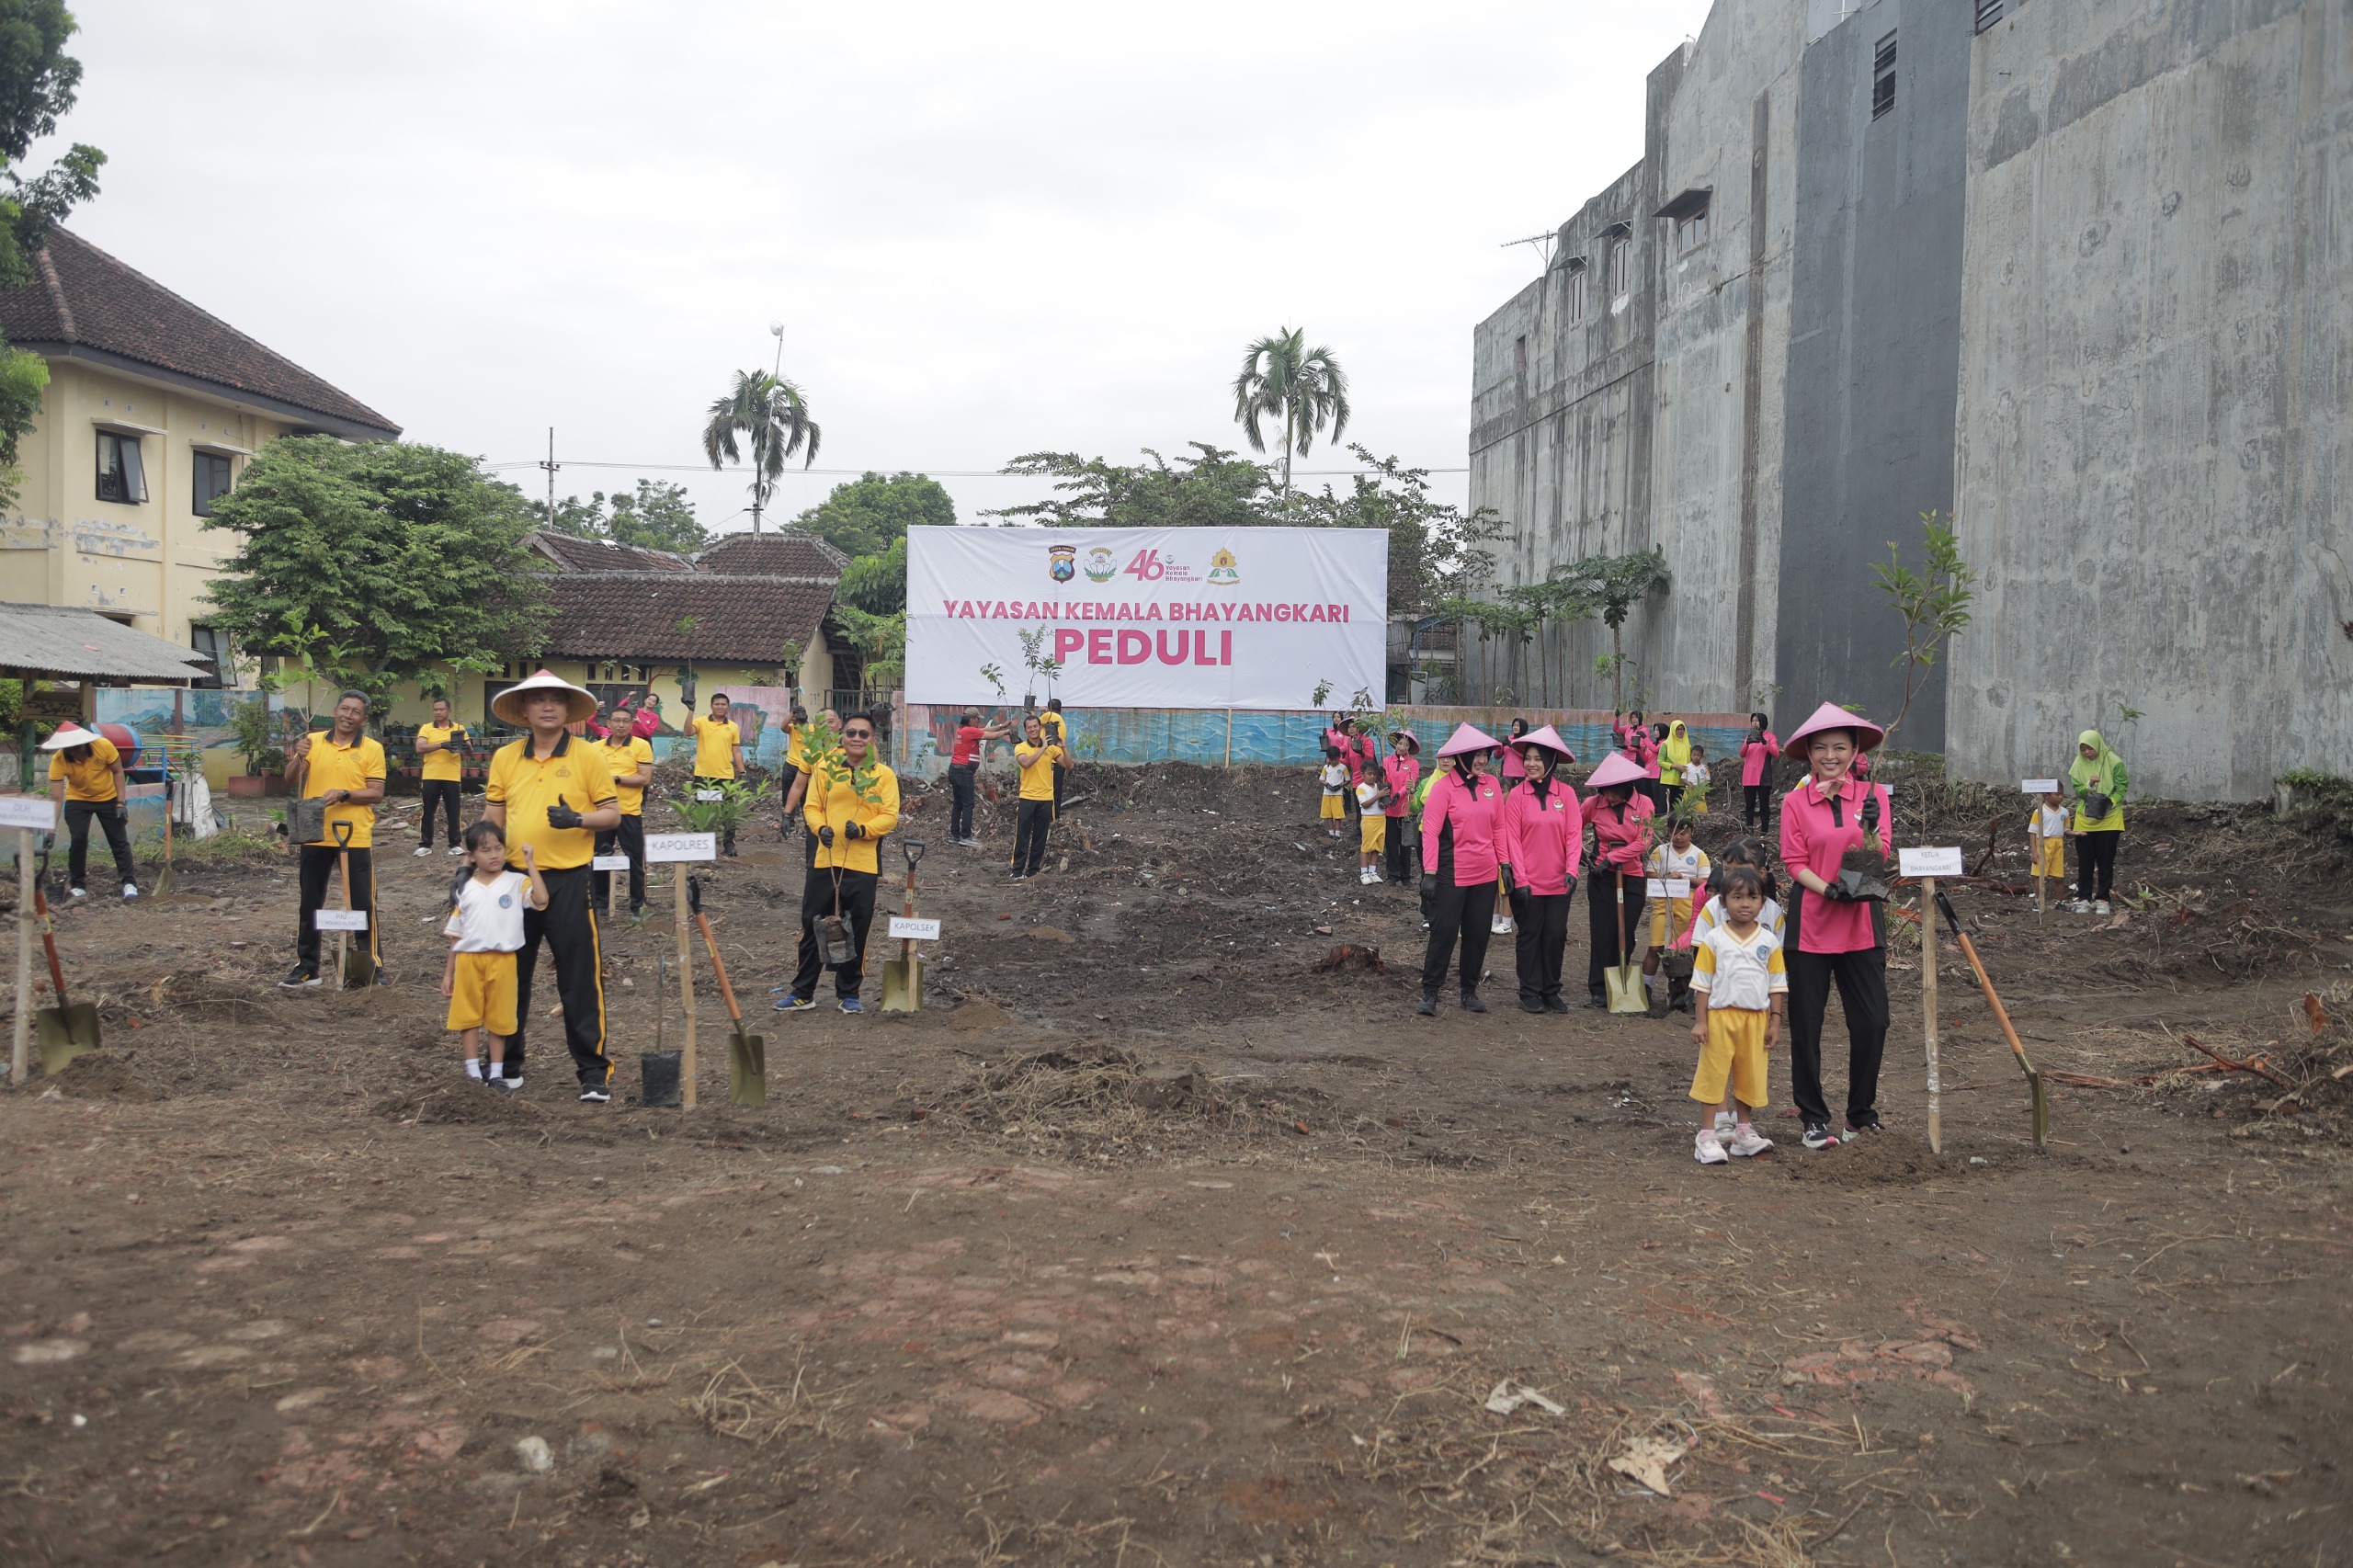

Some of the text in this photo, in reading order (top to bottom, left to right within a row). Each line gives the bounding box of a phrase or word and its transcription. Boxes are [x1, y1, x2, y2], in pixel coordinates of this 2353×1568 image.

[1122, 549, 1165, 582] 46
[943, 600, 1350, 623] YAYASAN KEMALA BHAYANGKARI
[1054, 628, 1233, 666] PEDULI
[652, 839, 710, 851] KAPOLRES
[894, 922, 936, 932] KAPOLSEK
